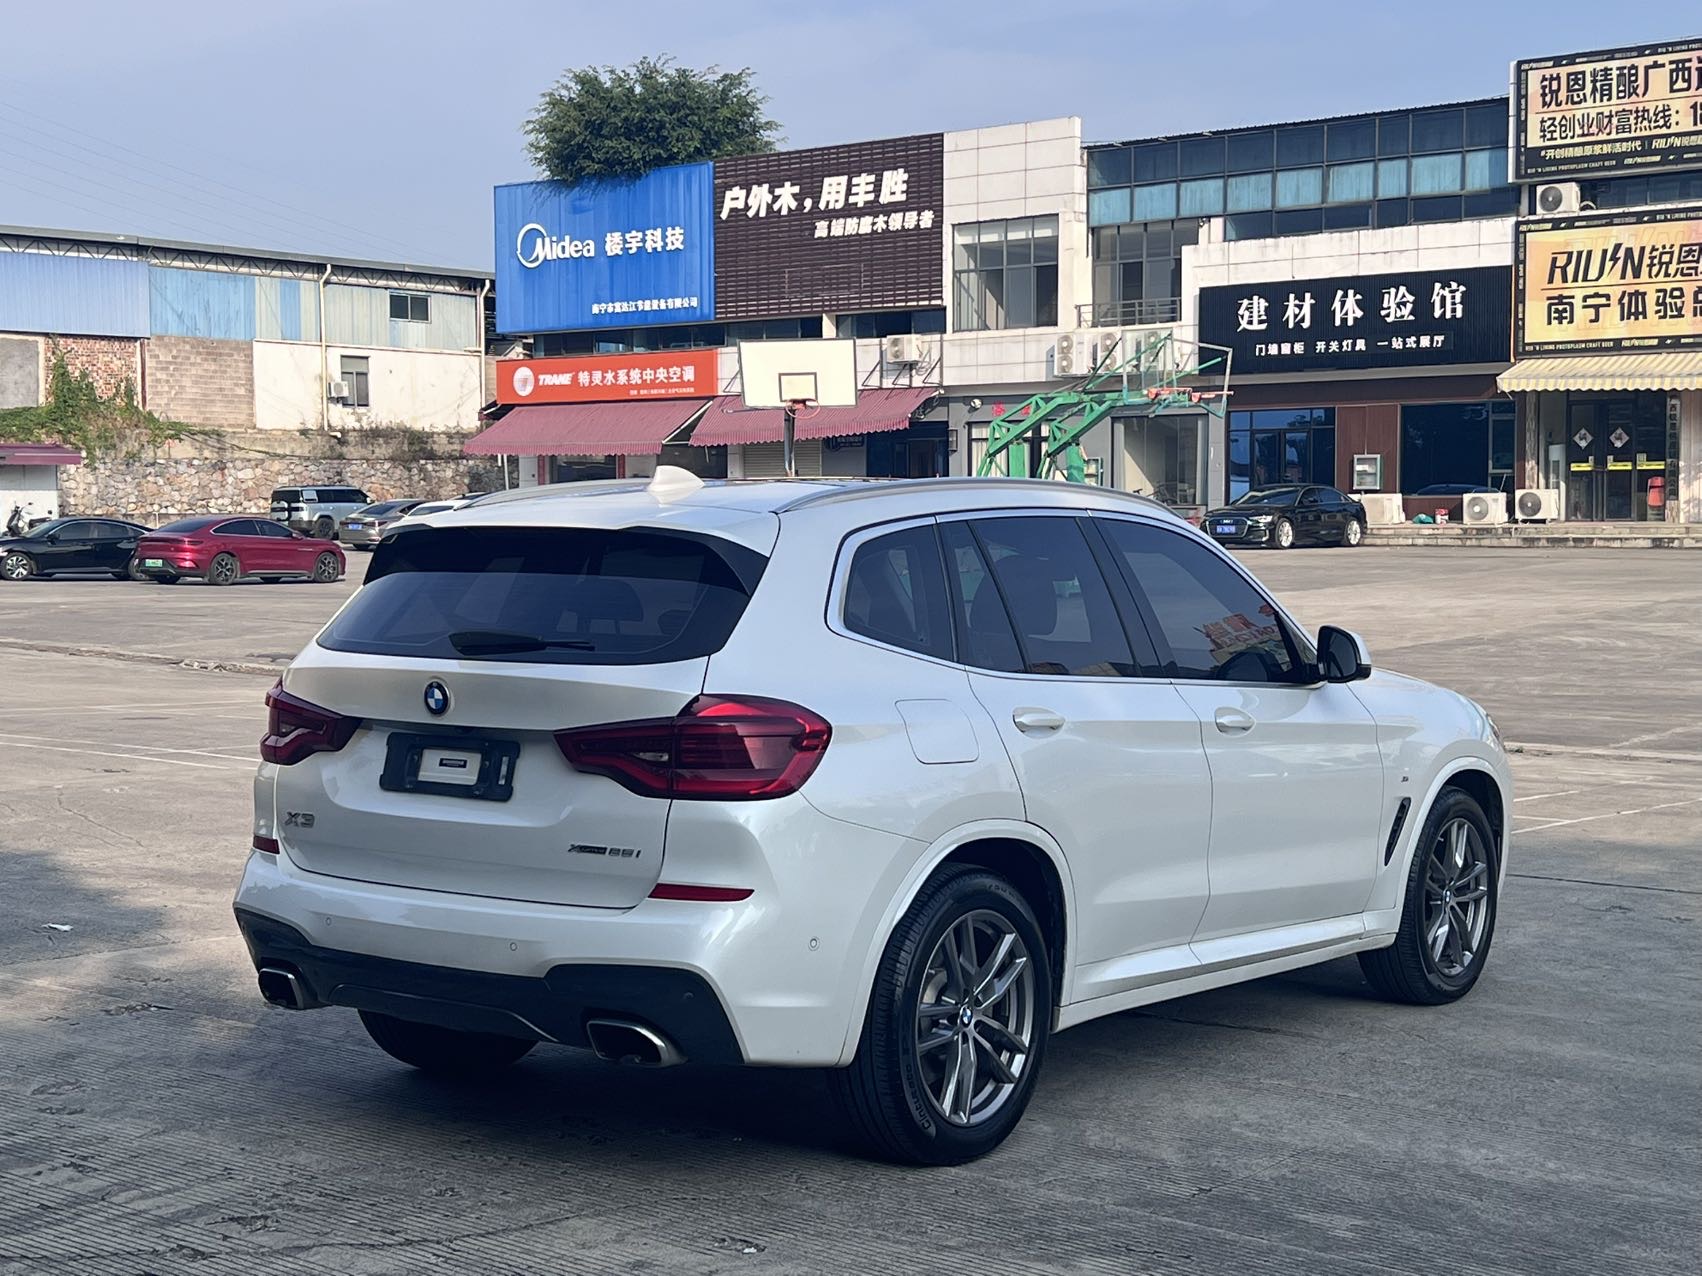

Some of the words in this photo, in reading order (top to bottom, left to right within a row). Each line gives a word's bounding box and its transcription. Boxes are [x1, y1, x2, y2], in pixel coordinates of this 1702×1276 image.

[1539, 55, 1702, 110] 锐恩精酿广西
[720, 168, 909, 220] 户外木，用丰胜
[814, 210, 935, 239] 高端防腐木领导者
[517, 223, 595, 269] Midea
[605, 226, 685, 257] 楼宇科技
[1236, 281, 1467, 332] 建材体验馆
[1315, 339, 1367, 353] 开关灯具
[1376, 335, 1445, 350] 一站式展厅
[537, 372, 575, 386] TRANE
[577, 365, 695, 388] 特灵水系统中央空调
[285, 811, 315, 828] X3
